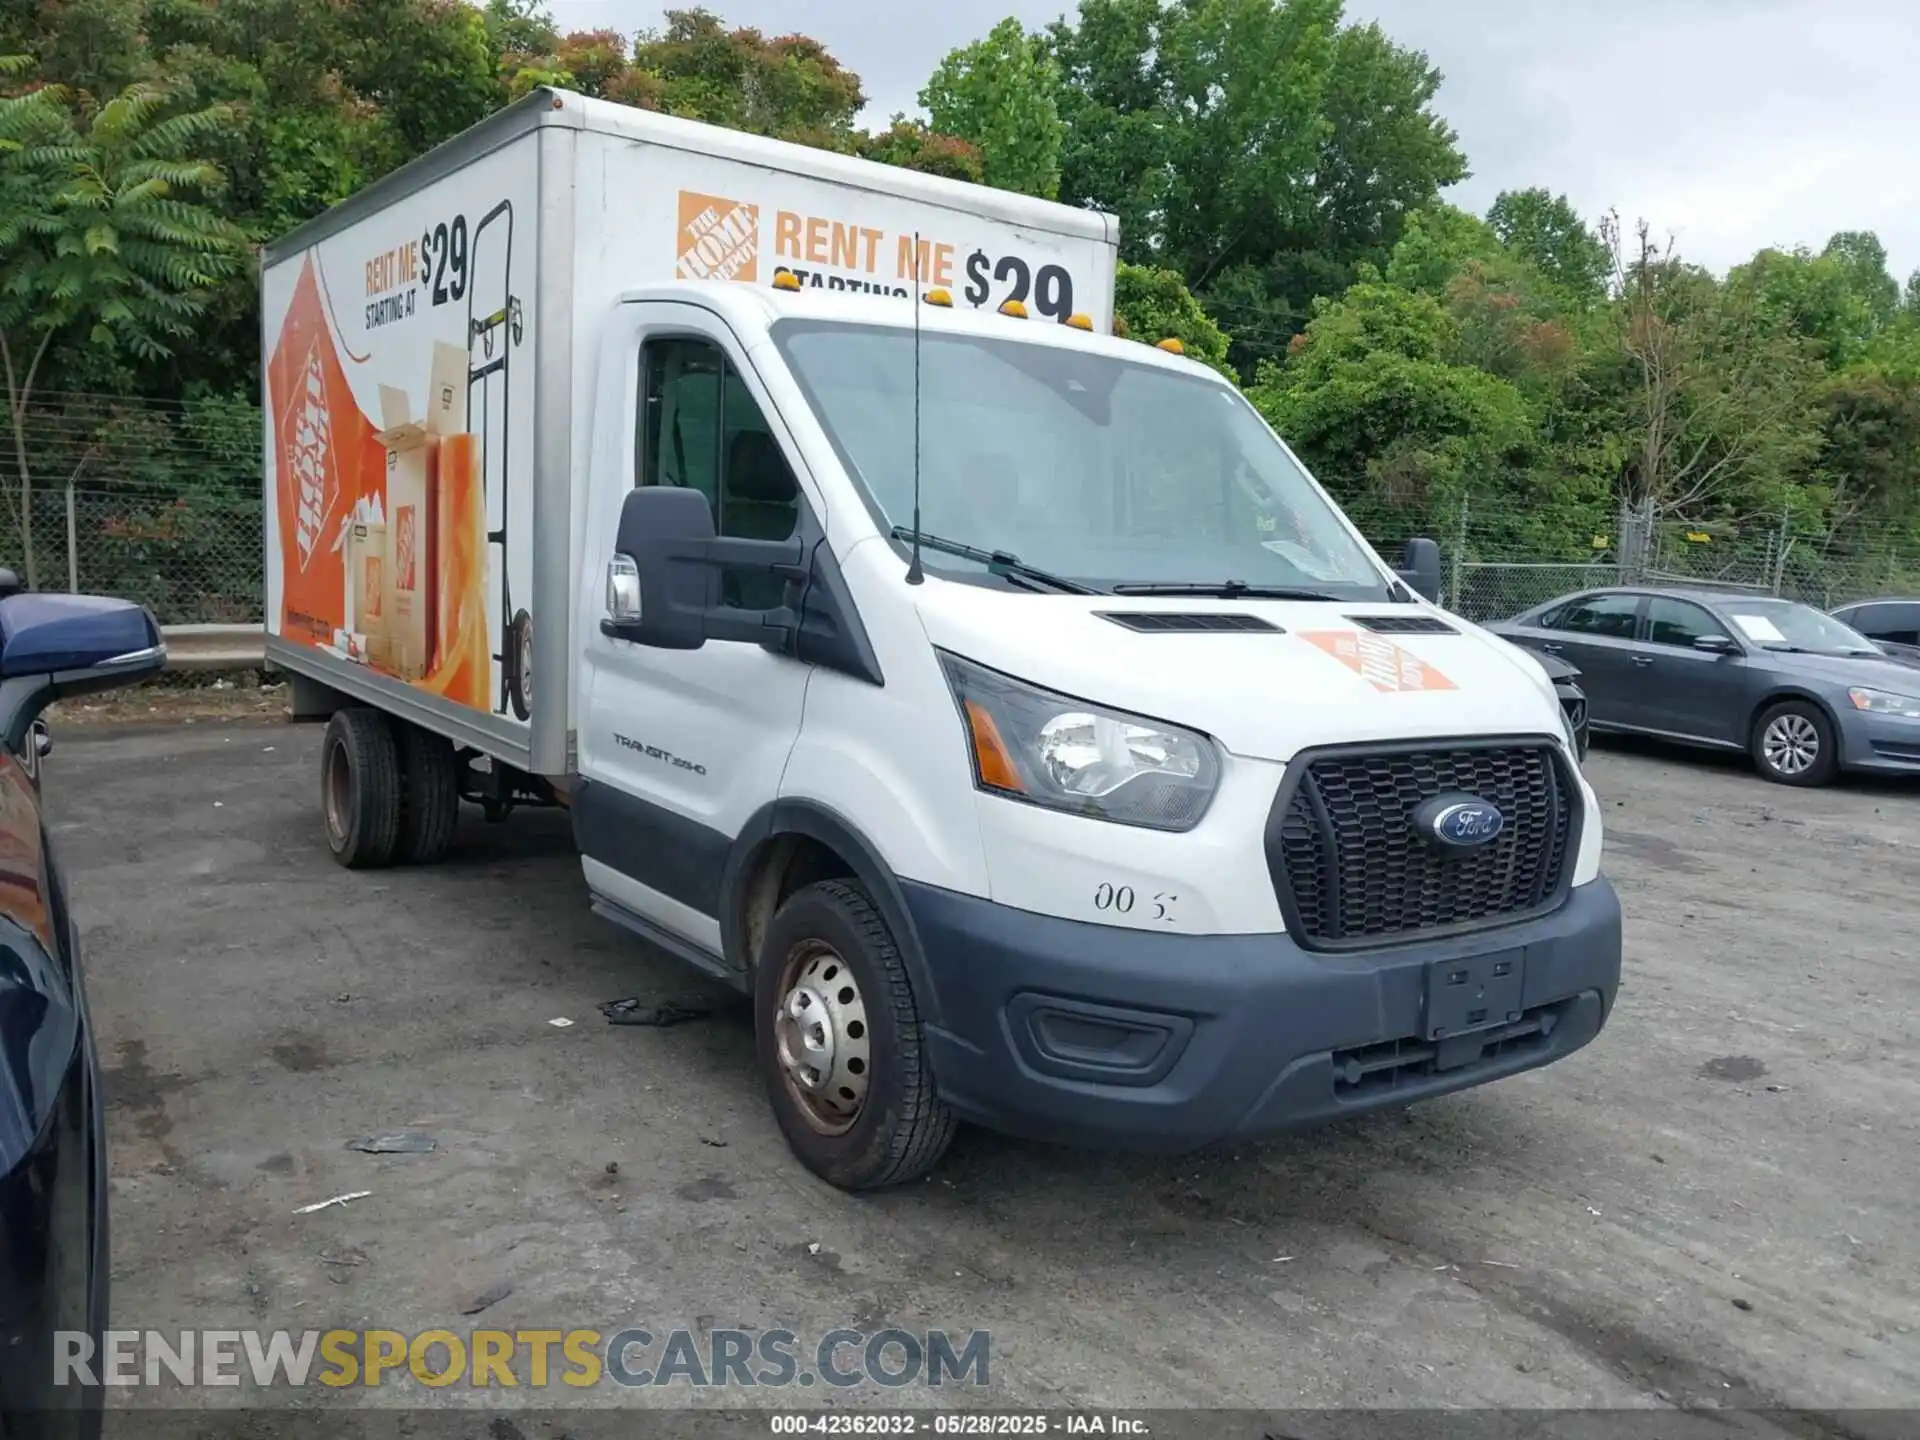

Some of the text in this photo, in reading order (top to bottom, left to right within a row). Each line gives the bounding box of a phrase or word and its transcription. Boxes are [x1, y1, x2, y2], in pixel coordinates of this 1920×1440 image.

[365, 240, 418, 298] RENT ME
[421, 214, 467, 307] $29
[775, 210, 884, 273] RENT
[896, 235, 955, 288] ME
[365, 287, 416, 330] STARTING AT
[965, 249, 1073, 324] $29
[1456, 811, 1493, 836] Ford
